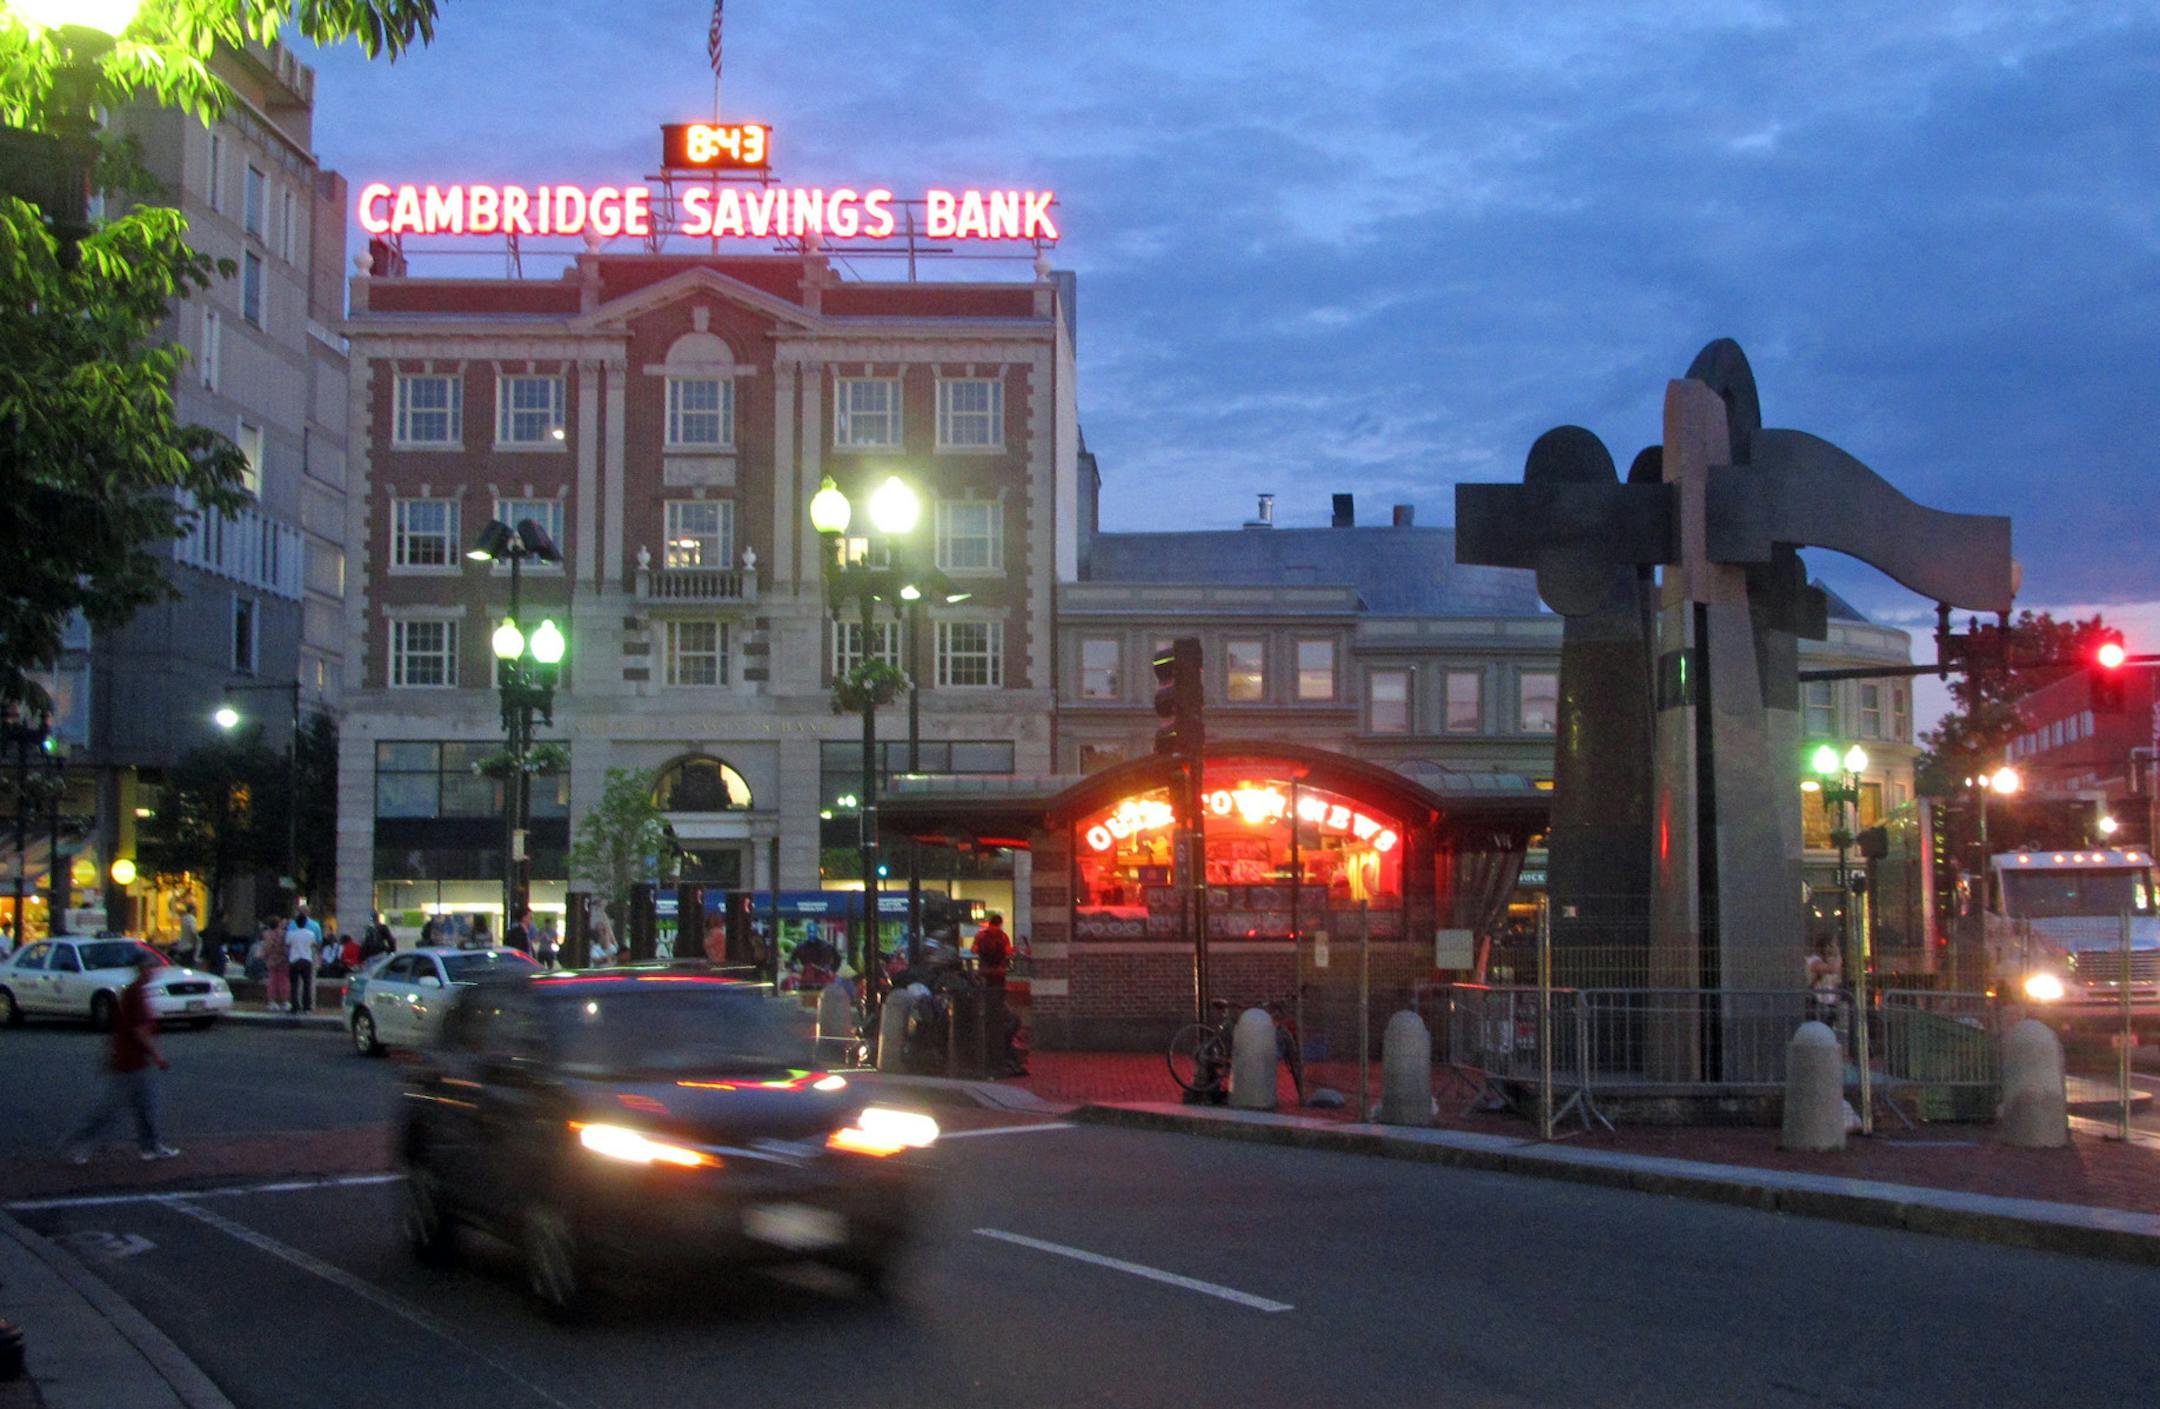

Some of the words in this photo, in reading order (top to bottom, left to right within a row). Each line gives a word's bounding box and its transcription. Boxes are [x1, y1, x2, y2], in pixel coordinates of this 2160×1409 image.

[687, 124, 765, 163] 8:43
[358, 182, 651, 237] CAMBRIDGE
[680, 186, 895, 239] SAVINGS
[926, 189, 1060, 240] BANK
[1296, 796, 1398, 852] NEWS
